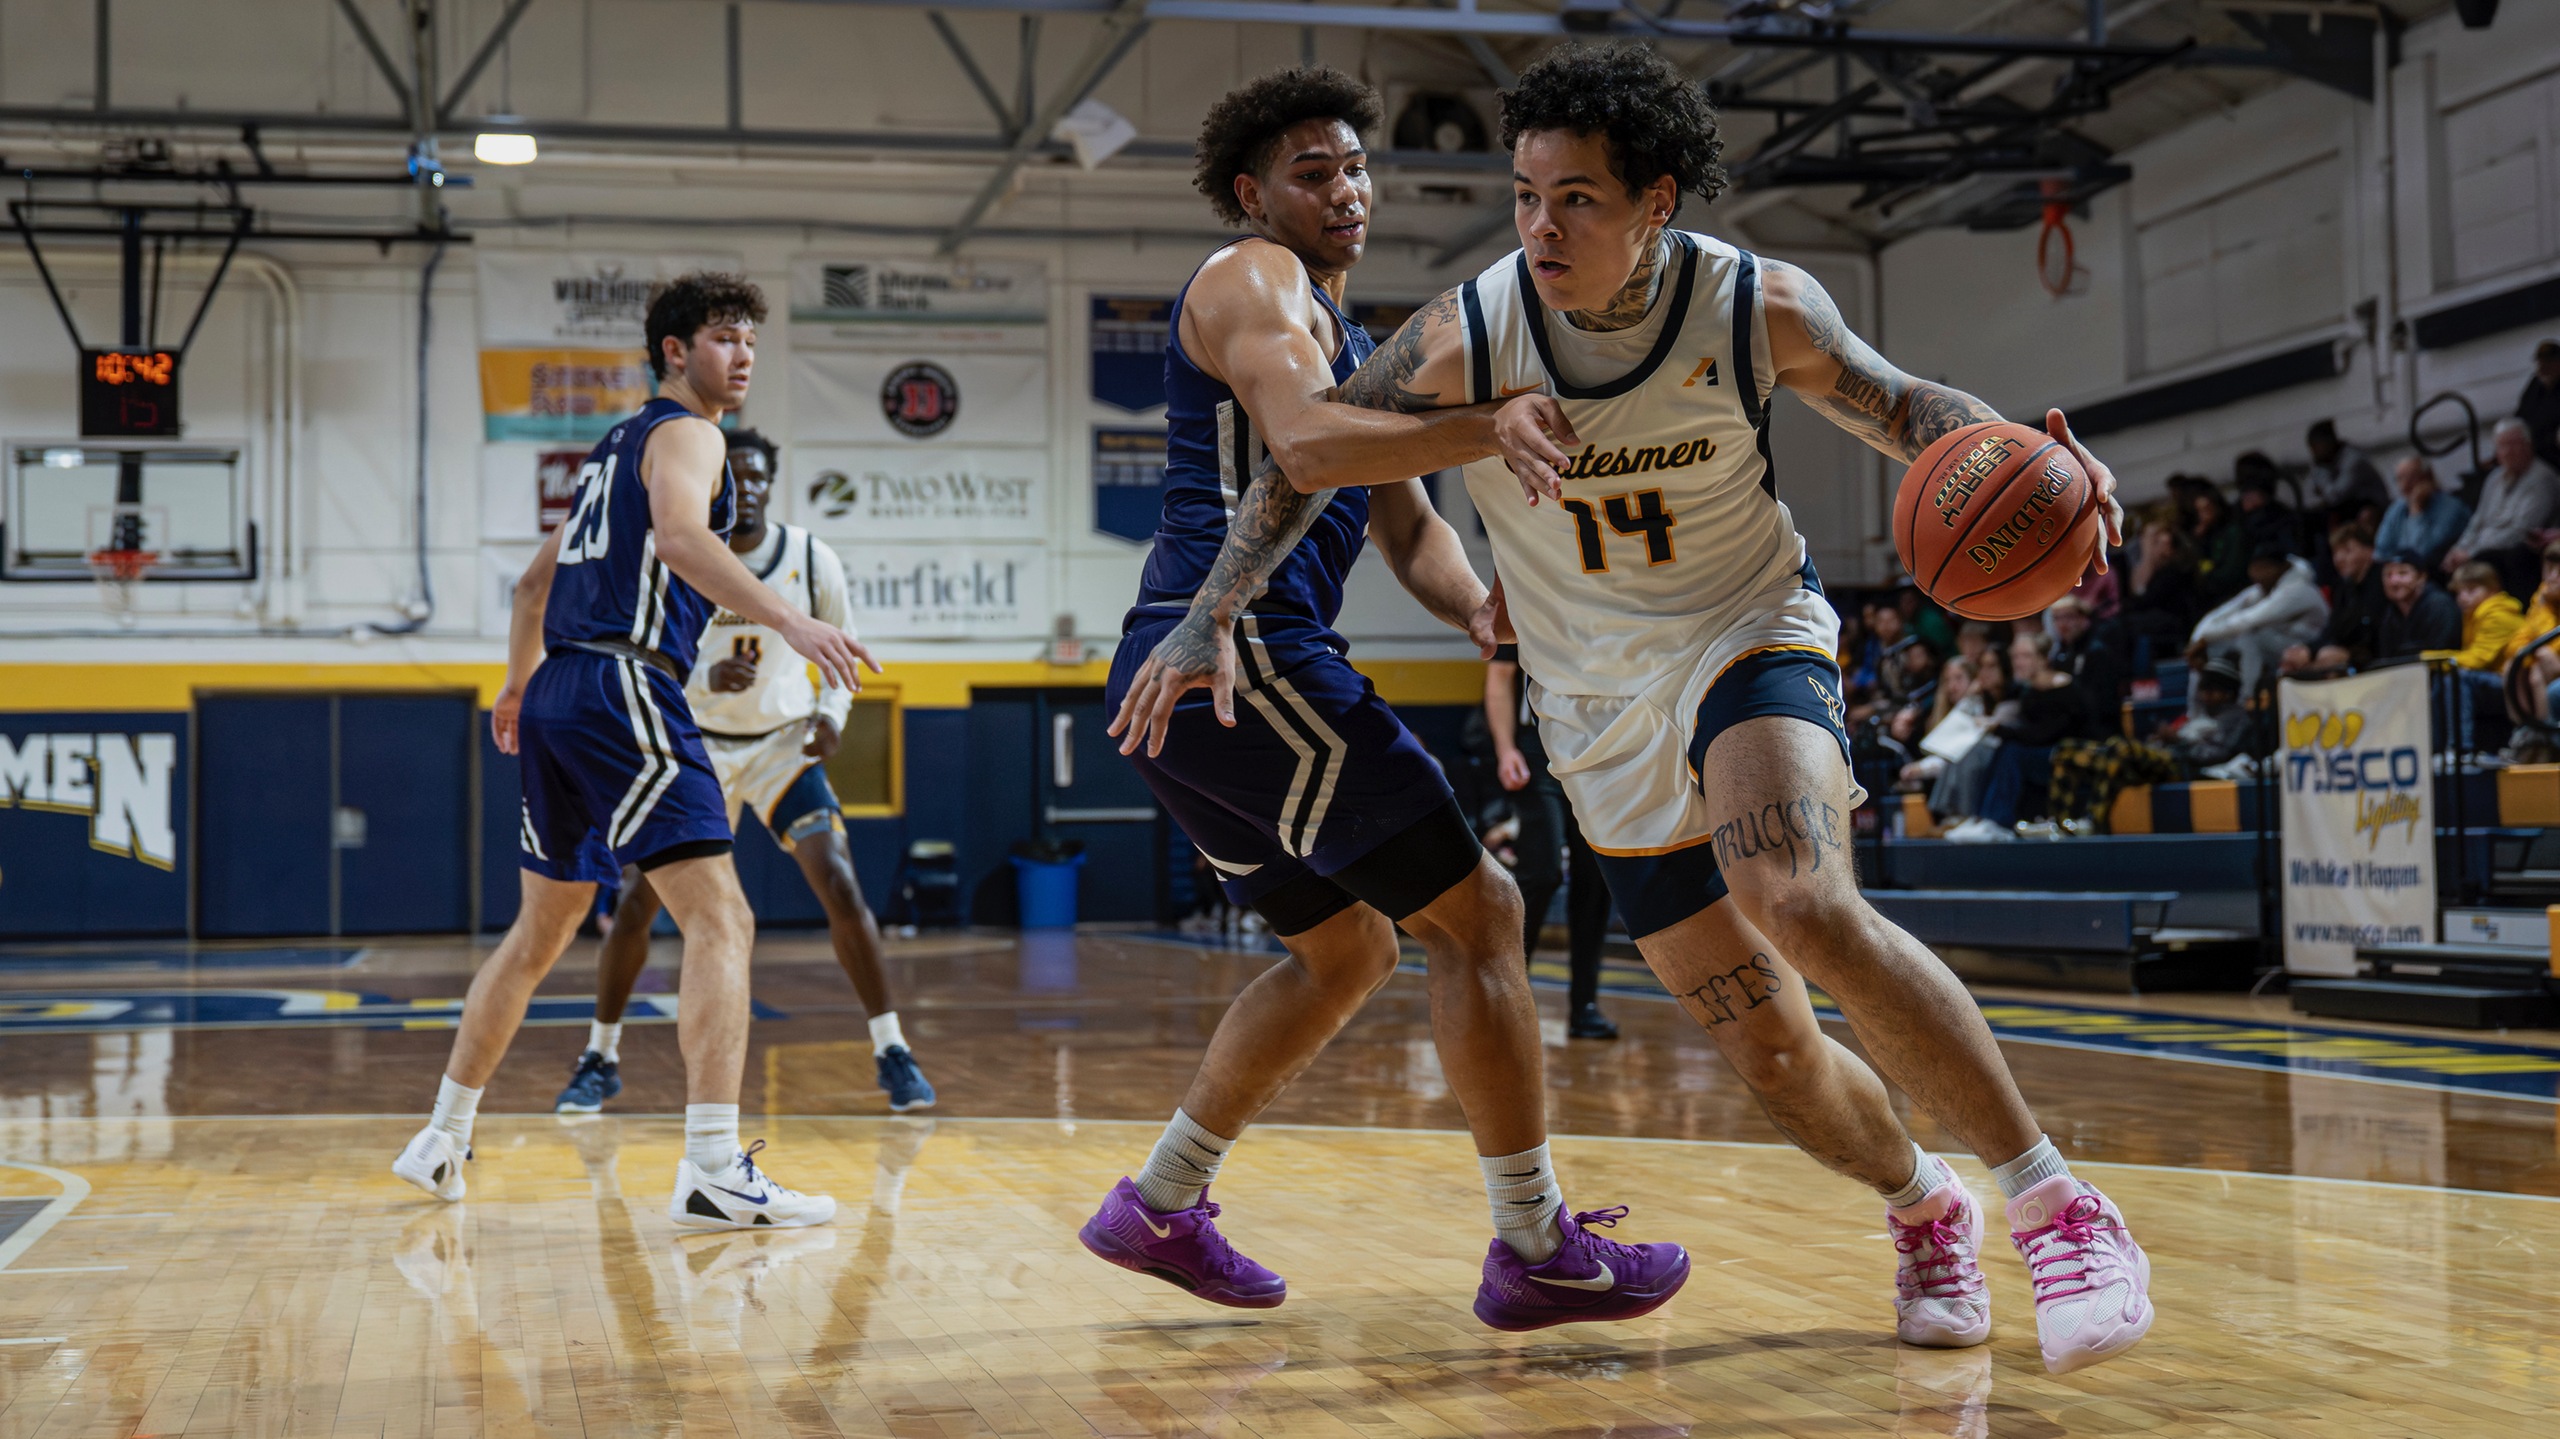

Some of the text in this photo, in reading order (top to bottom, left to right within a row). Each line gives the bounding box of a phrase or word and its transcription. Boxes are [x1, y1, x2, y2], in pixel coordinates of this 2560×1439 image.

[1941, 438, 2026, 530] LEGACY
[1966, 456, 2074, 575] SPALDING
[1559, 487, 1678, 575] 14
[842, 559, 1015, 608] airfield
